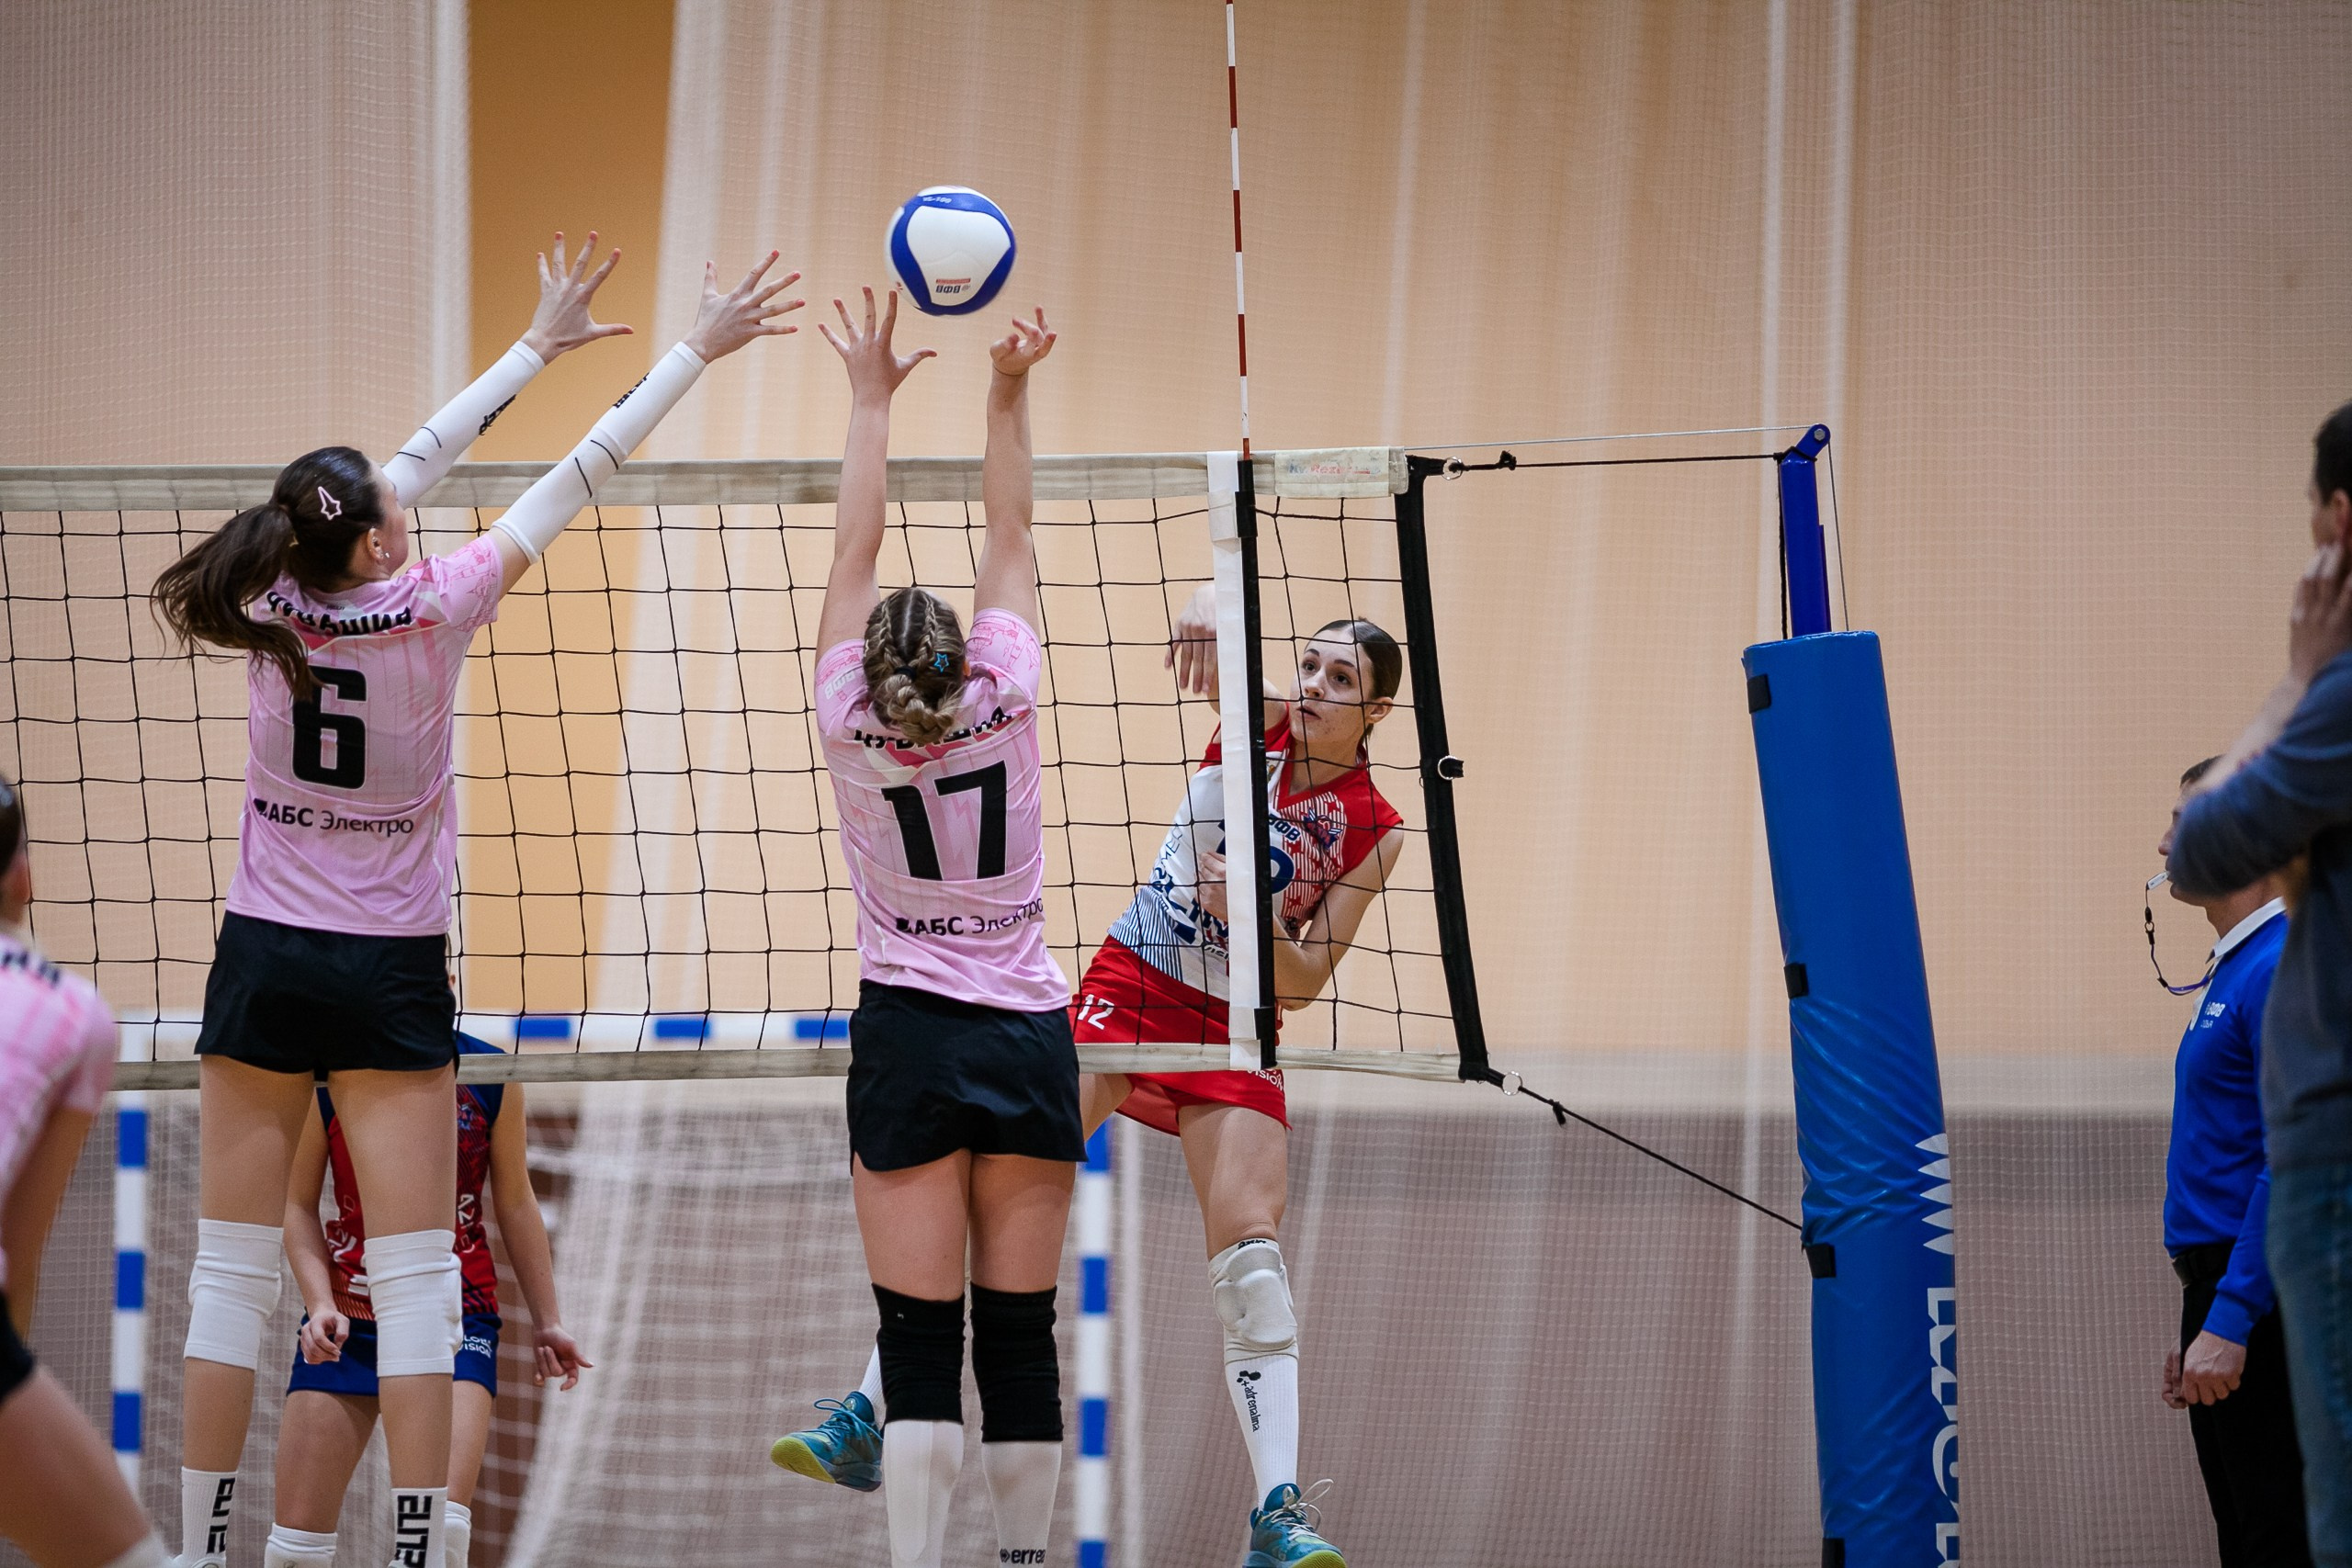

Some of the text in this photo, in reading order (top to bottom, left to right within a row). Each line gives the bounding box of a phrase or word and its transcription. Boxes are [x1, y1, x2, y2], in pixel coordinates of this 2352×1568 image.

[292, 665, 368, 790] 6
[267, 803, 414, 838] АБС Электро
[880, 759, 1010, 881] 17
[914, 916, 965, 937] АБС
[1077, 993, 1115, 1031] 12
